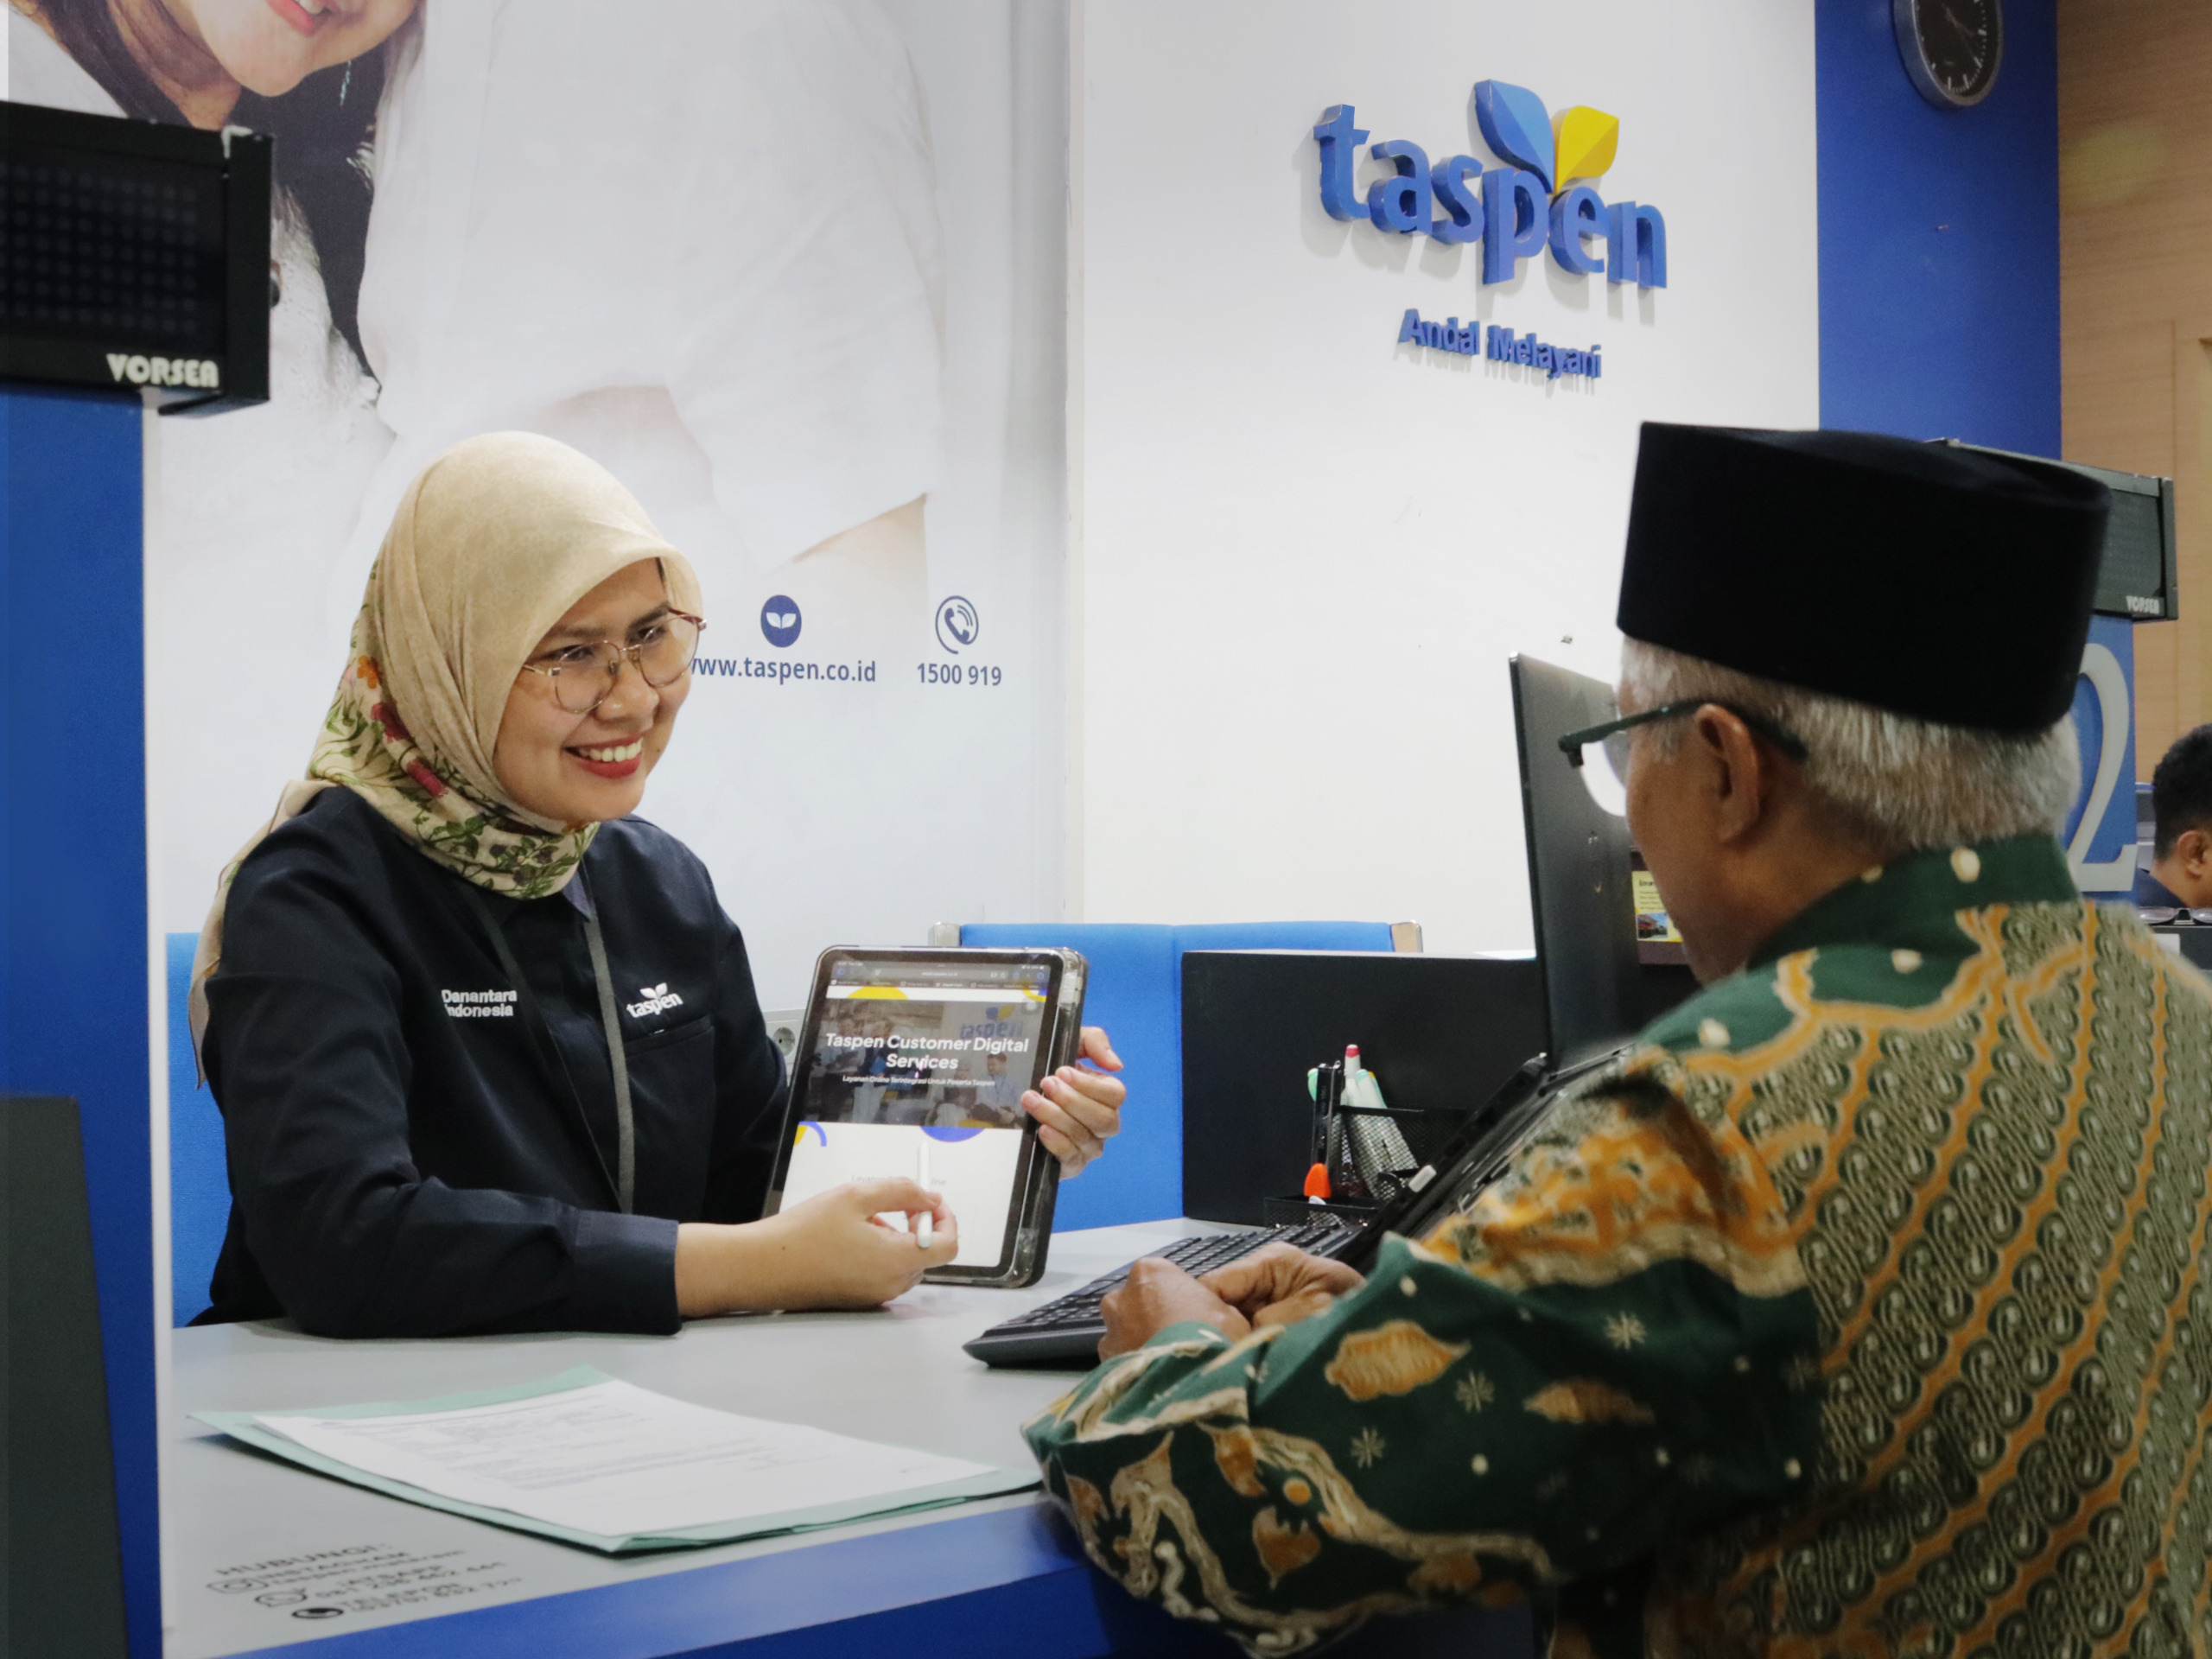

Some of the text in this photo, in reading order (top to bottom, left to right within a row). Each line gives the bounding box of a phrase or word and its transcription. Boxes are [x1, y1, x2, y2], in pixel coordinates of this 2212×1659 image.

[1313, 104, 1667, 289] taspen
[1398, 308, 1601, 379] Andal Melayani
[917, 663, 1002, 686] 1500 919
[2067, 643, 2138, 892] 2
[441, 989, 518, 1003] Danantara
[626, 993, 683, 1018] taspen
[826, 1033, 1030, 1054] Taspen Customer Digital
[886, 1053, 959, 1070] Services
